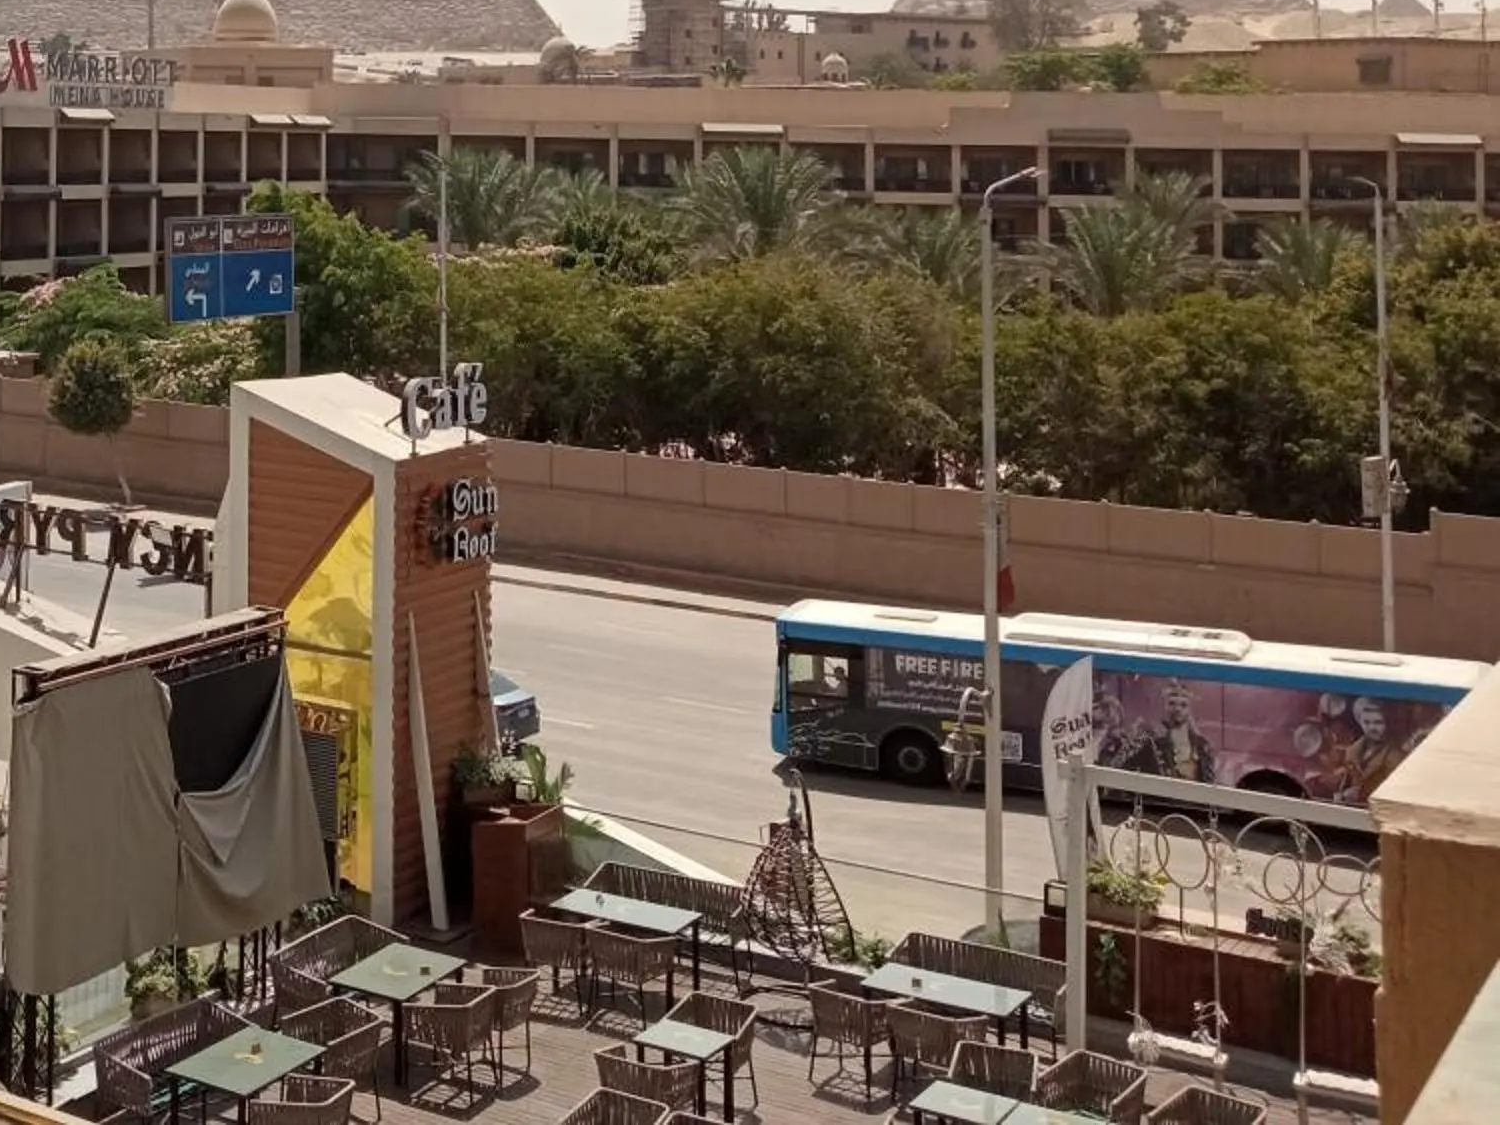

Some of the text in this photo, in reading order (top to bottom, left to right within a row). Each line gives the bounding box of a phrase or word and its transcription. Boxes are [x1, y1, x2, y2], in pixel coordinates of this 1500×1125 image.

[47, 51, 178, 86] MARRIOTT
[110, 86, 166, 109] HOUSE
[401, 362, 488, 441] Café
[452, 477, 499, 523] Sun
[894, 654, 985, 680] FREE FIRE
